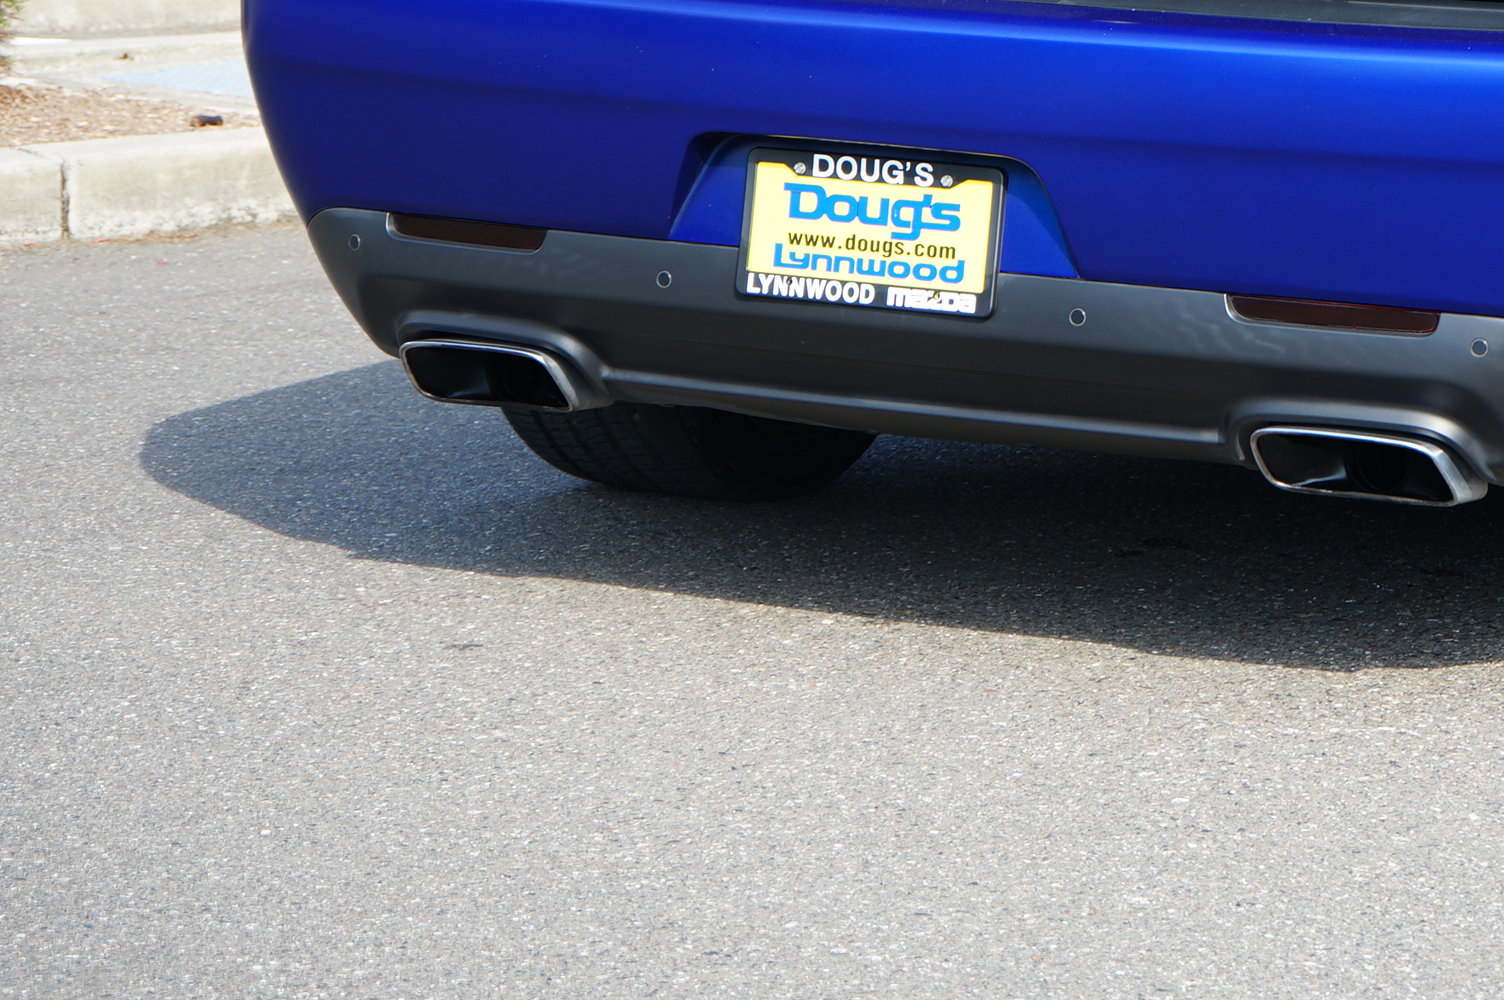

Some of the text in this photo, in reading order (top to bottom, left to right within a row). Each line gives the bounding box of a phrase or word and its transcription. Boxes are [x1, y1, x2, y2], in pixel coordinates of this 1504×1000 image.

[812, 153, 934, 187] DOUG'S
[783, 182, 961, 241] Doug's
[773, 243, 965, 284] Lynnwood
[788, 232, 956, 260] www.dougs.com
[746, 272, 977, 315] LYNNWOOD mazda
